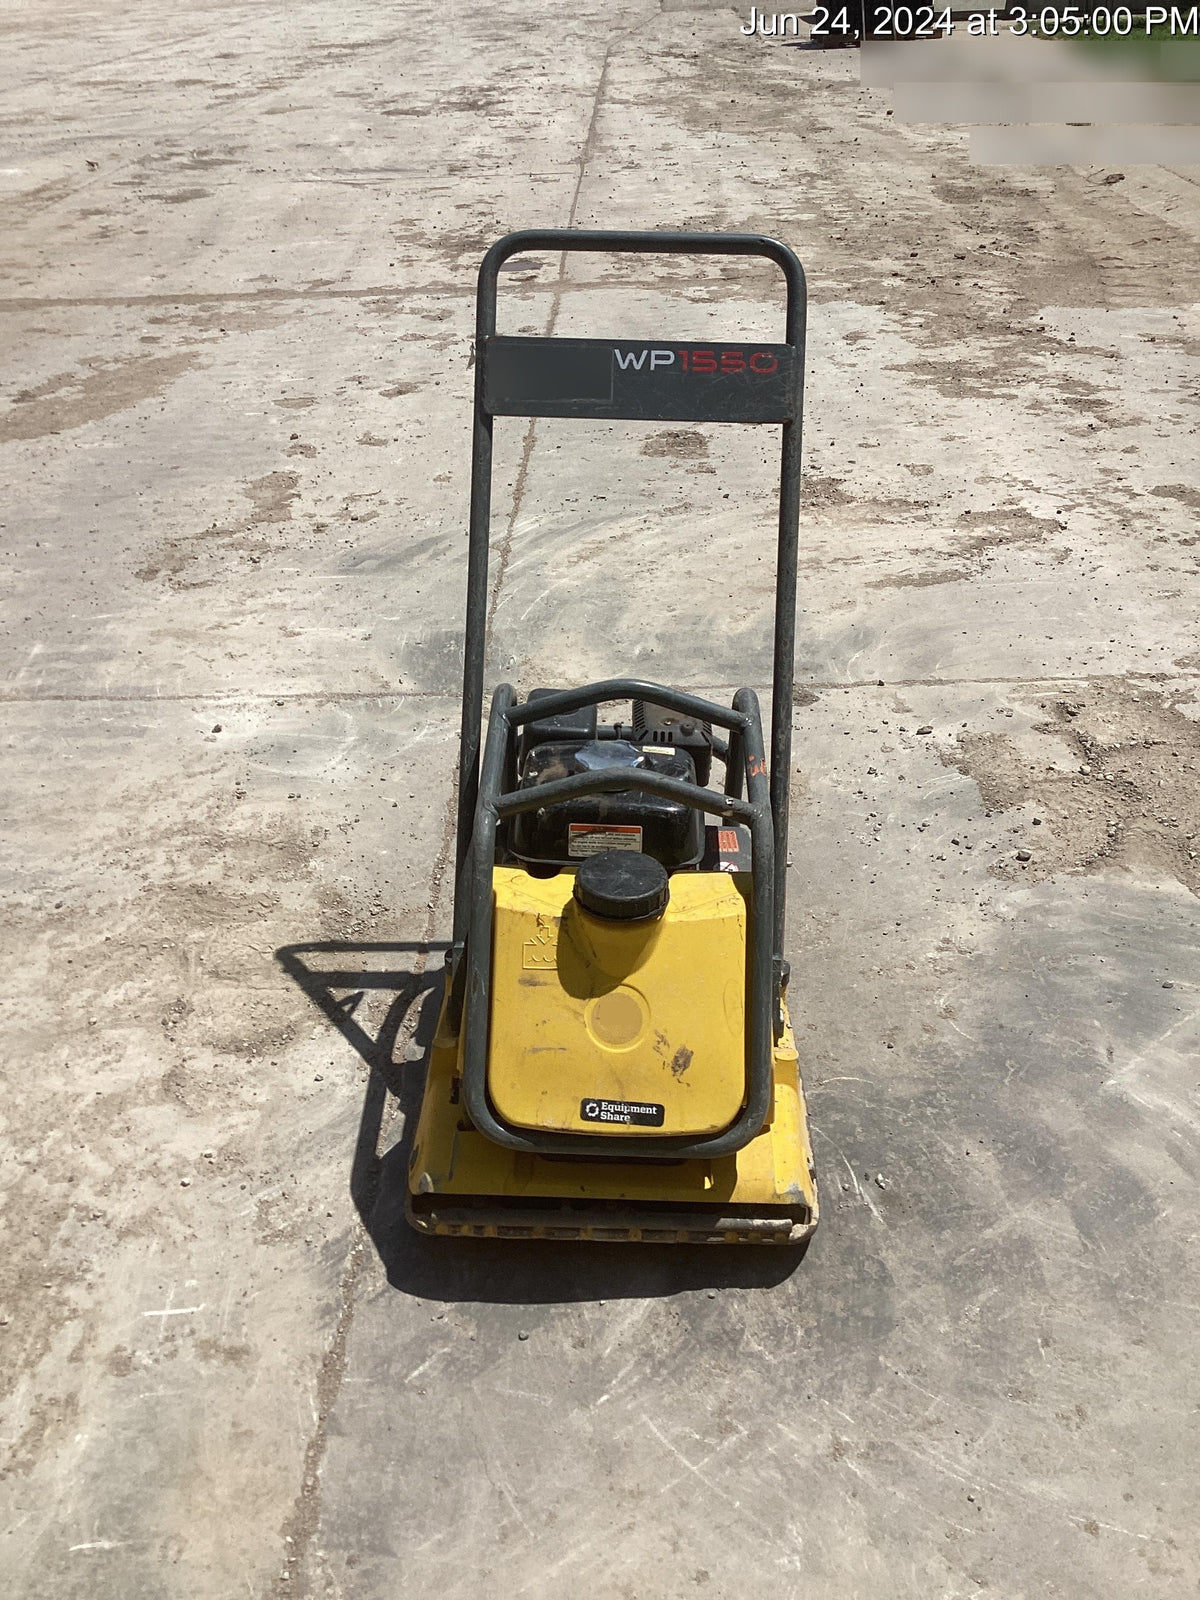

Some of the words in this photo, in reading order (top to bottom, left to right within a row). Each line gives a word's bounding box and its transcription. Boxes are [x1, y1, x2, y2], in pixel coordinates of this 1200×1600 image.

[614, 349, 779, 374] WP1550
[601, 1102, 657, 1115] Equipment
[600, 1111, 631, 1122] Share
